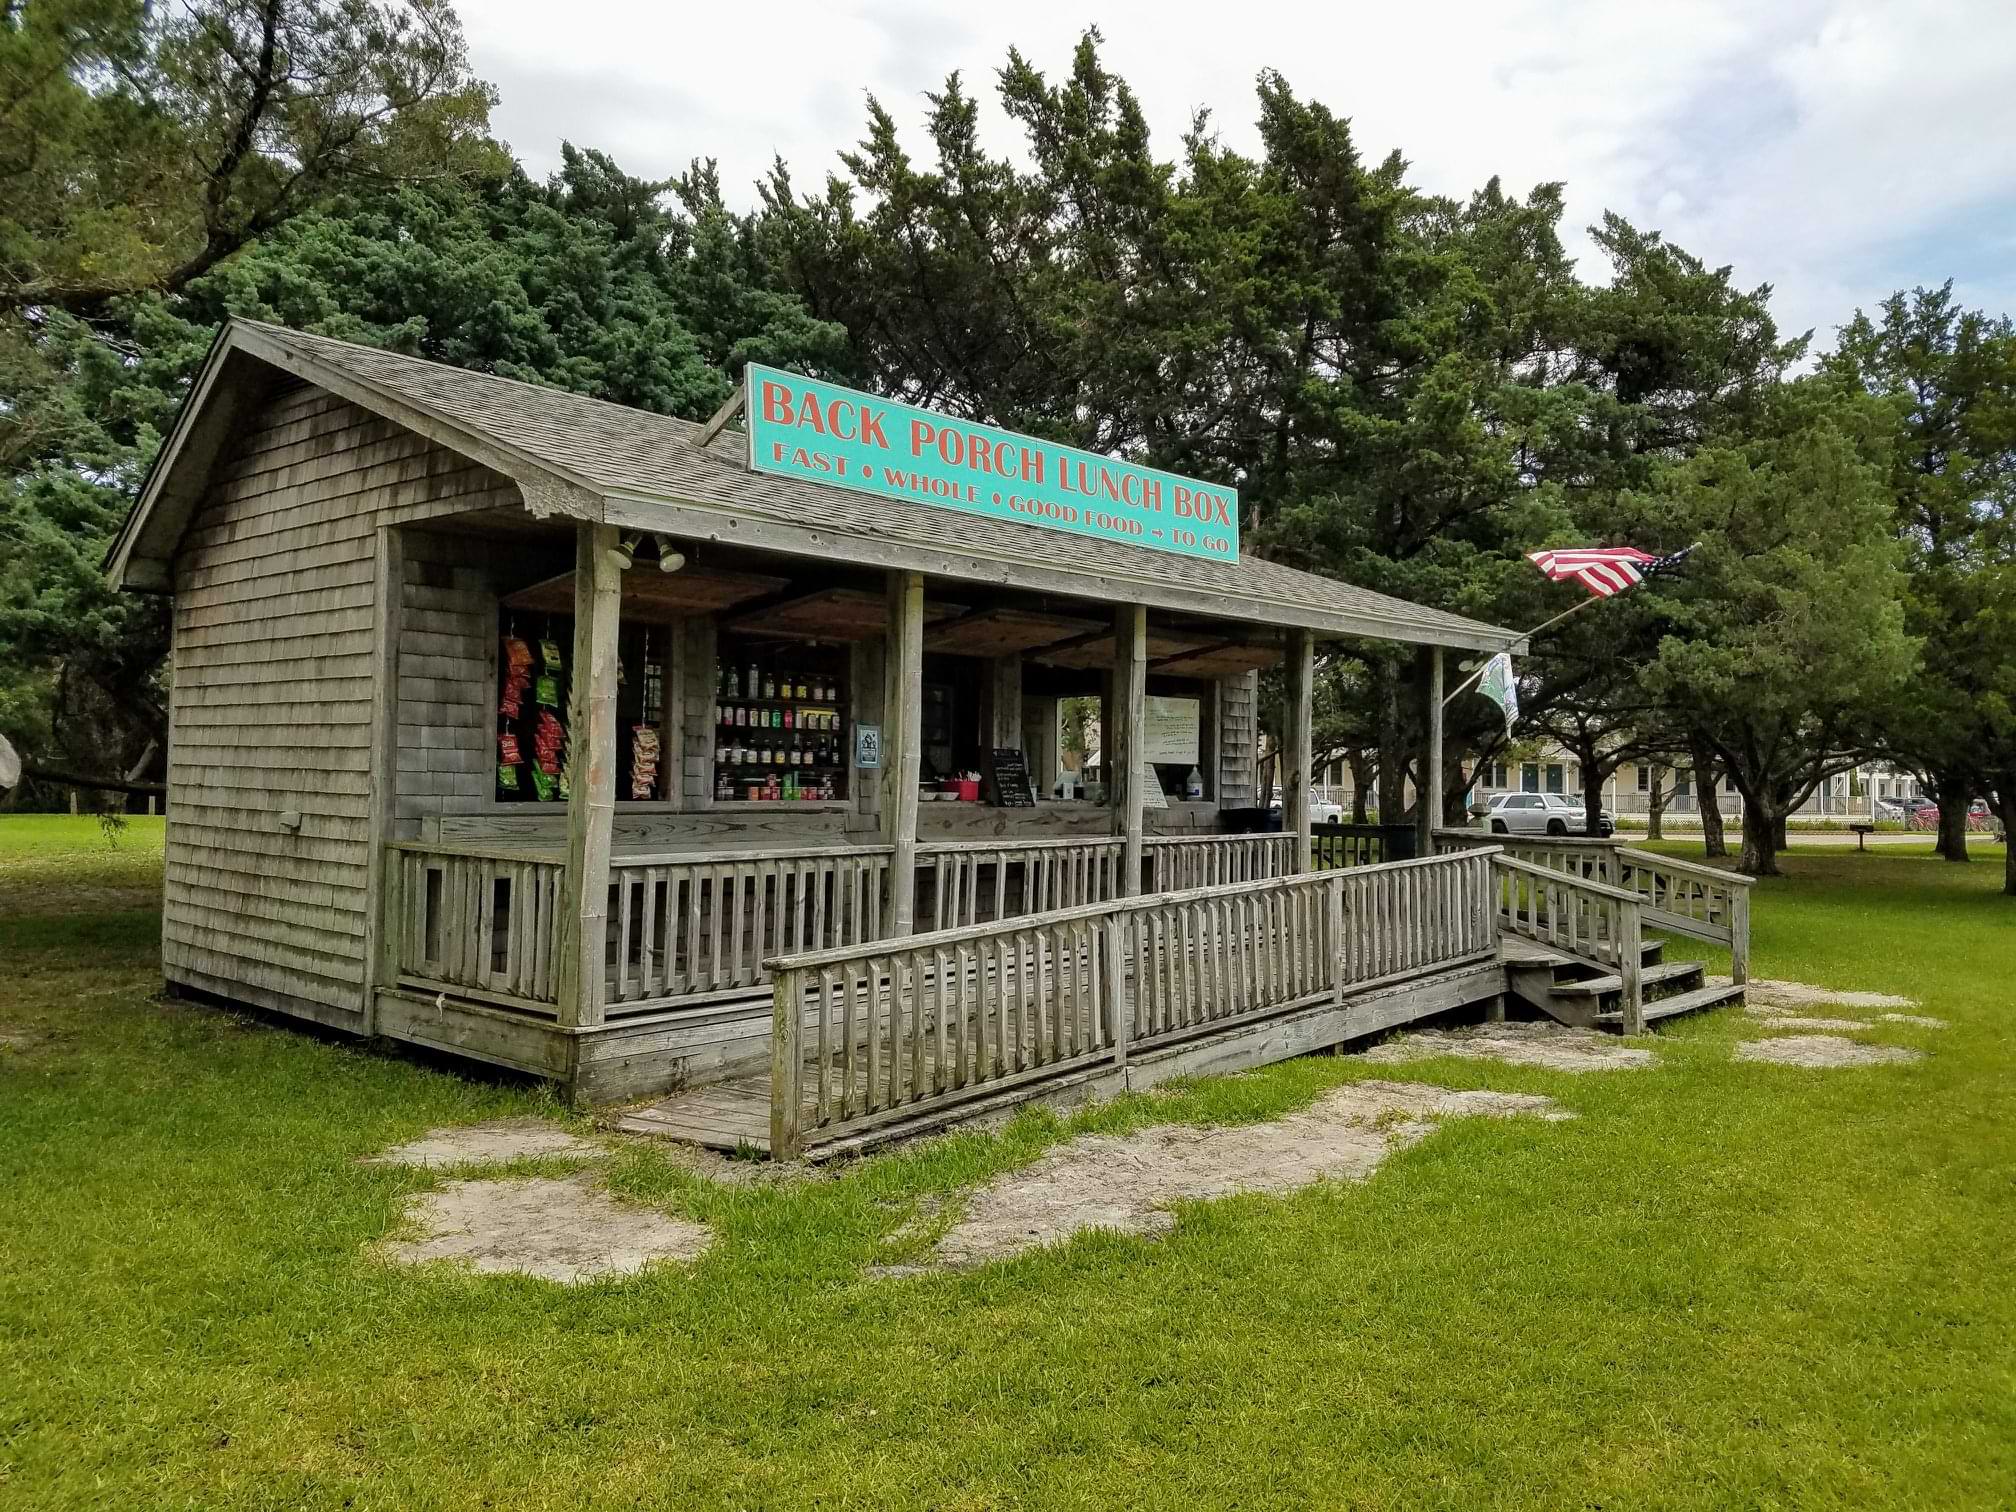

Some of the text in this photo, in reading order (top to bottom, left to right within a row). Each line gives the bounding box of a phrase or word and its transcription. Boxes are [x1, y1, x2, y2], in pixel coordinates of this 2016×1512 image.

[762, 381, 1232, 527] BACK PORCH LUNCH BOX
[773, 442, 1230, 553] FAST WHOLE GOOD FOOD TO GO
